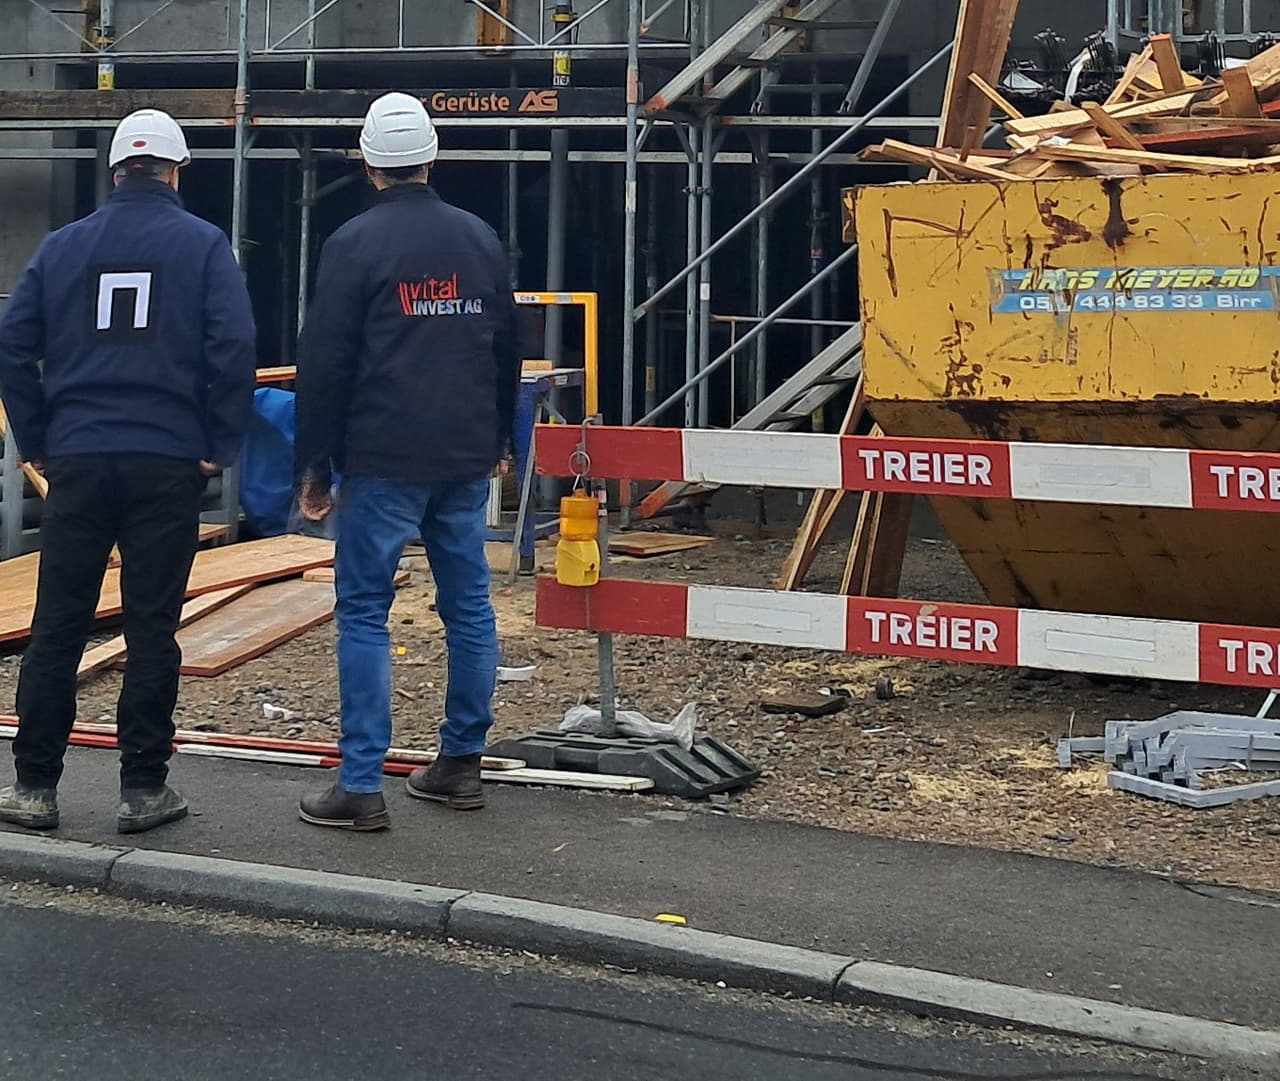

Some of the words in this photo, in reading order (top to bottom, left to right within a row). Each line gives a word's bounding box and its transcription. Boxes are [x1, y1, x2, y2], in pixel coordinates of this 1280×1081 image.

[431, 91, 510, 112] Gerüste
[518, 90, 558, 111] AG
[411, 273, 458, 299] vital
[412, 299, 464, 316] INVEST
[464, 299, 482, 314] AG
[1133, 295, 1165, 309] 83
[1172, 295, 1204, 308] 33
[1216, 294, 1262, 308] Birr
[858, 449, 993, 486] TREIER
[864, 611, 1000, 654] TREIER
